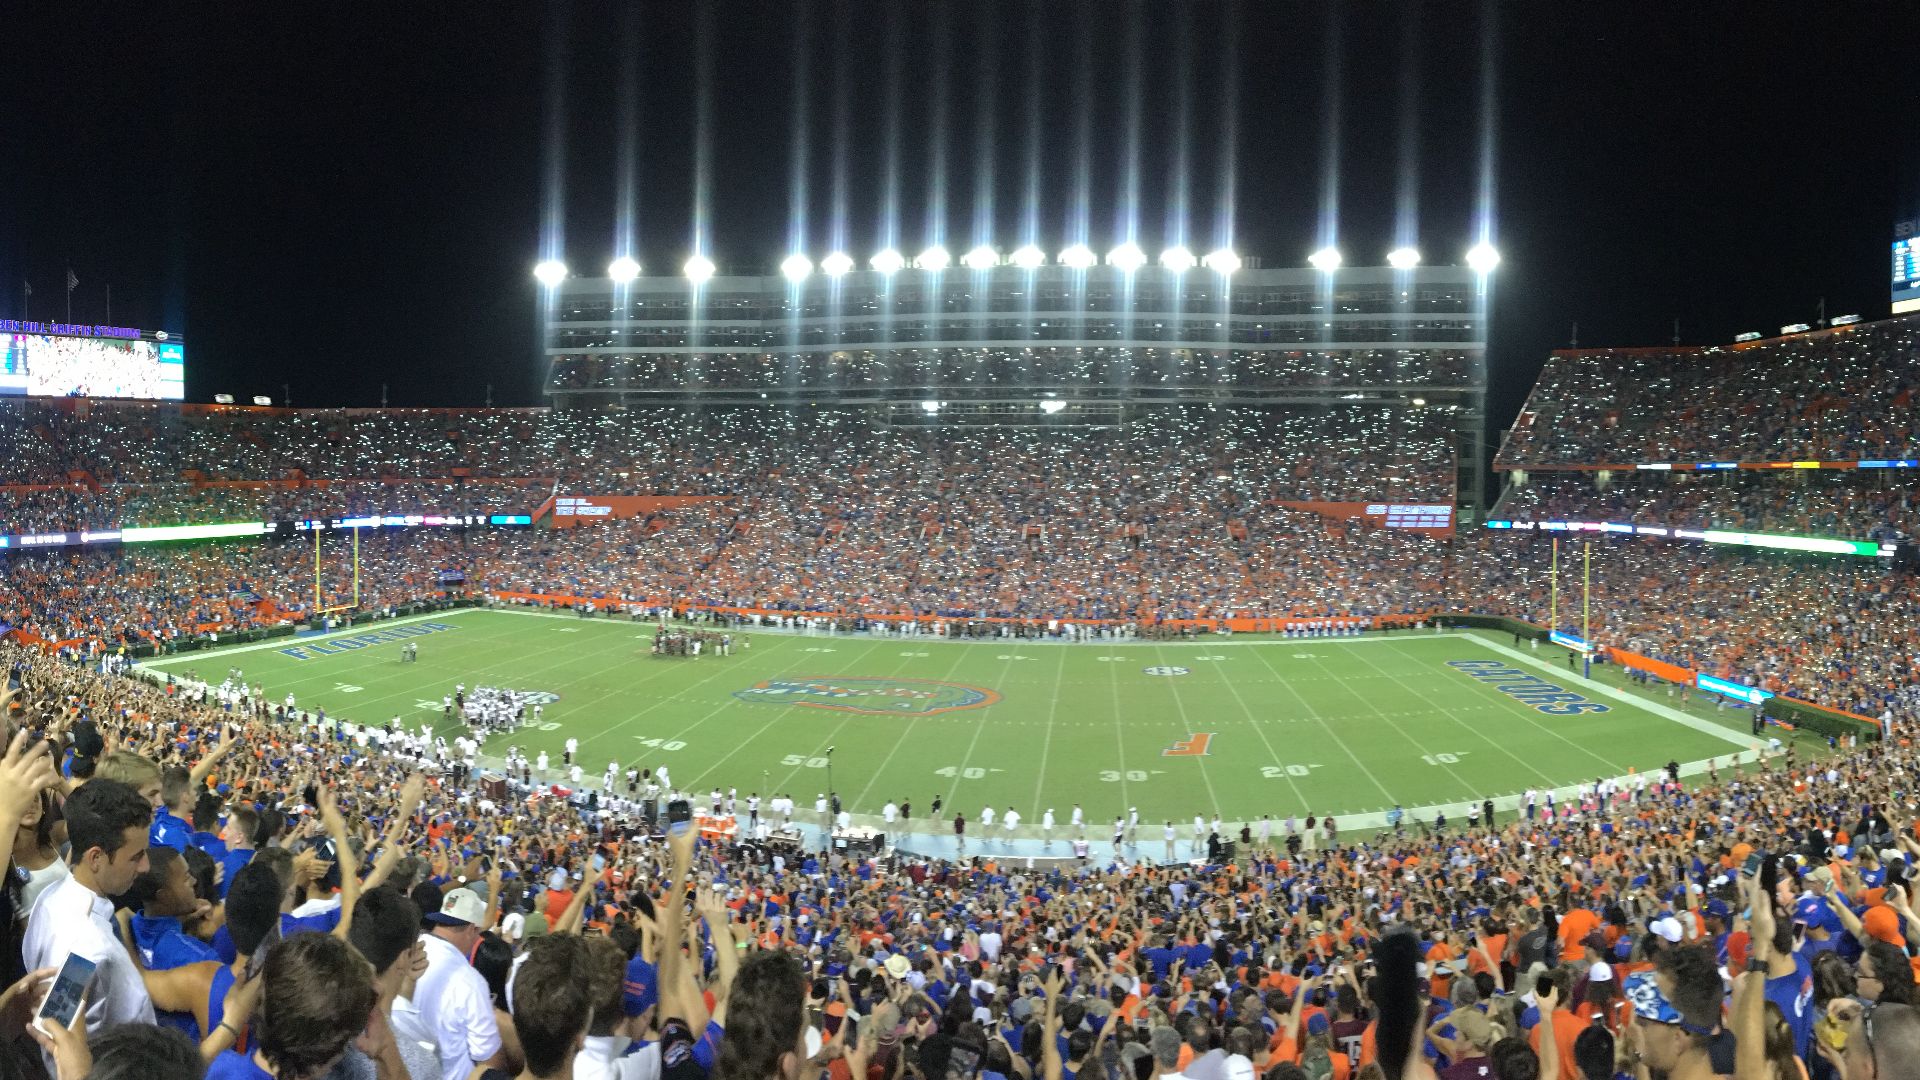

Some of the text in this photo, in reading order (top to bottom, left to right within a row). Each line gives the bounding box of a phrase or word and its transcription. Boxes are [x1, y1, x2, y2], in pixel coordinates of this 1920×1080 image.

[23, 321, 47, 333] HILL
[50, 323, 91, 336] GRIFFIN
[94, 325, 140, 339] STADIUM
[273, 622, 462, 660] FLORIDA
[1444, 660, 1613, 715] GATORS
[640, 738, 687, 751] 40
[780, 754, 829, 768] 50
[1421, 753, 1460, 766] 10
[934, 766, 986, 779] 40
[1099, 770, 1148, 782] 30
[1260, 764, 1310, 778] 20
